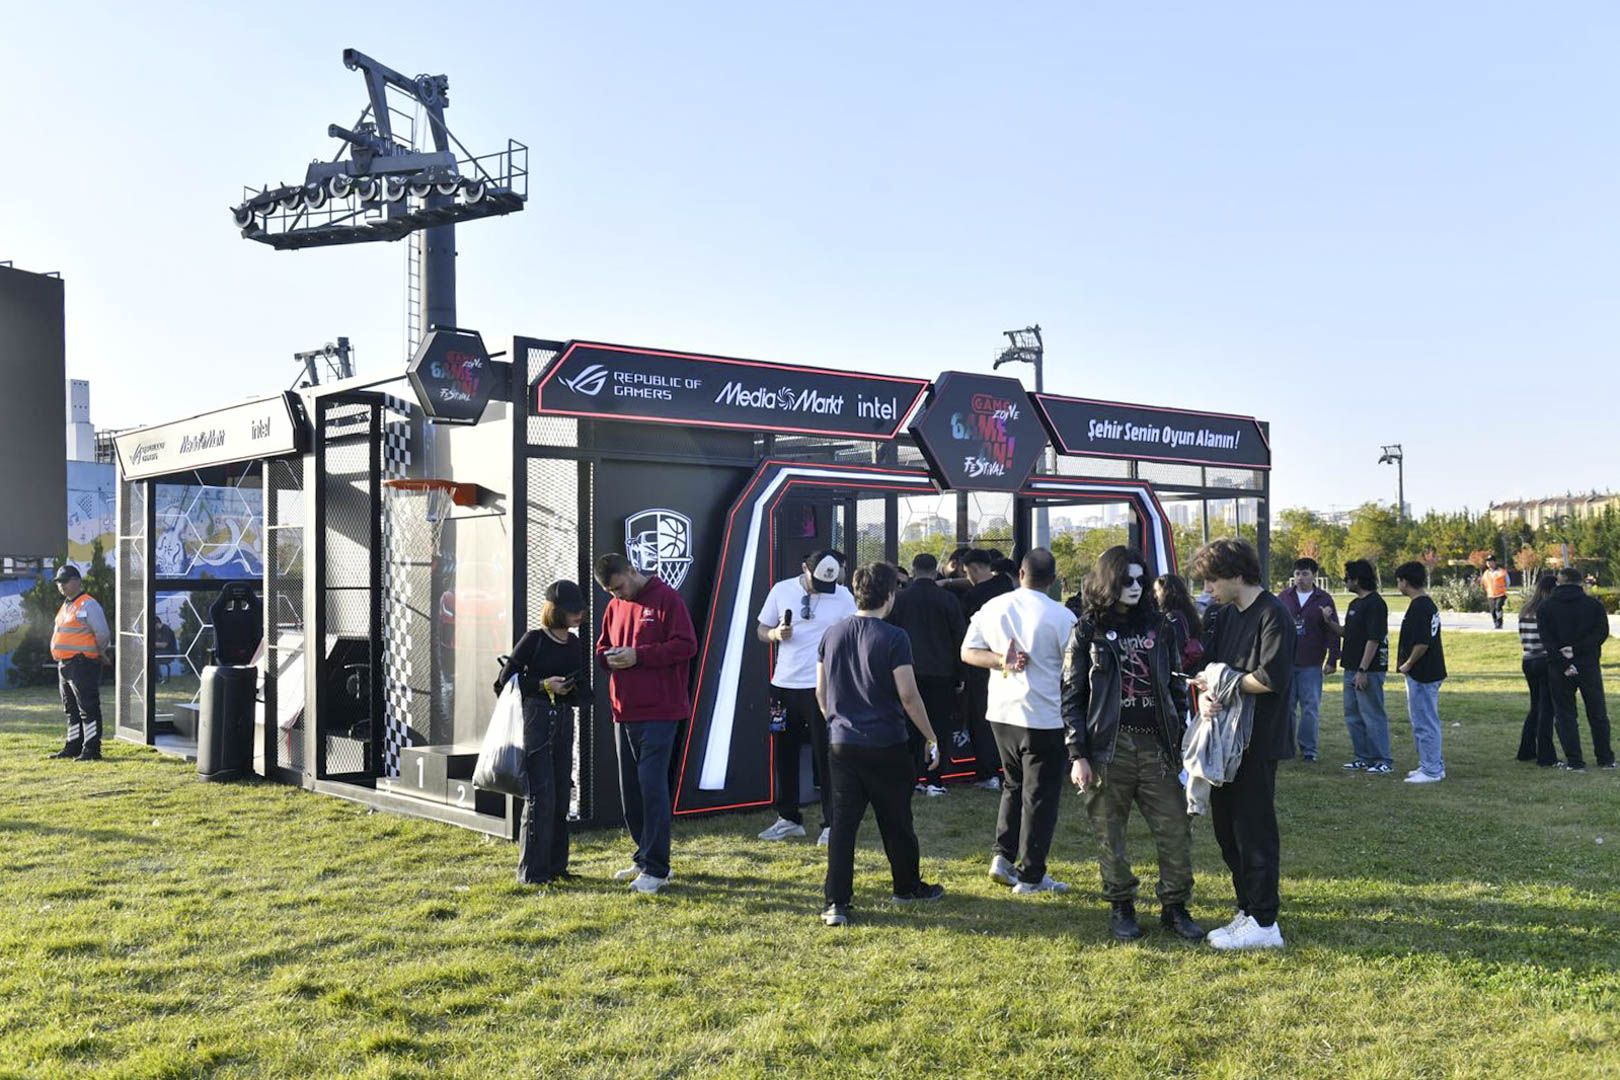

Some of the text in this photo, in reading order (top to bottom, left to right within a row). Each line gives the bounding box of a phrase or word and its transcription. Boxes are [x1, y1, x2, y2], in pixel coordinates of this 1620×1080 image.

[614, 371, 702, 389] REPUBLIC OF
[614, 385, 672, 401] GAMERS
[857, 394, 897, 420] intel
[251, 416, 271, 441] intel
[1088, 418, 1124, 442] Şehir
[1124, 422, 1160, 443] Senin
[1162, 426, 1195, 448] Oyun
[963, 456, 1006, 478] FESTIVAL
[416, 756, 424, 789] 1
[456, 784, 466, 808] 2
